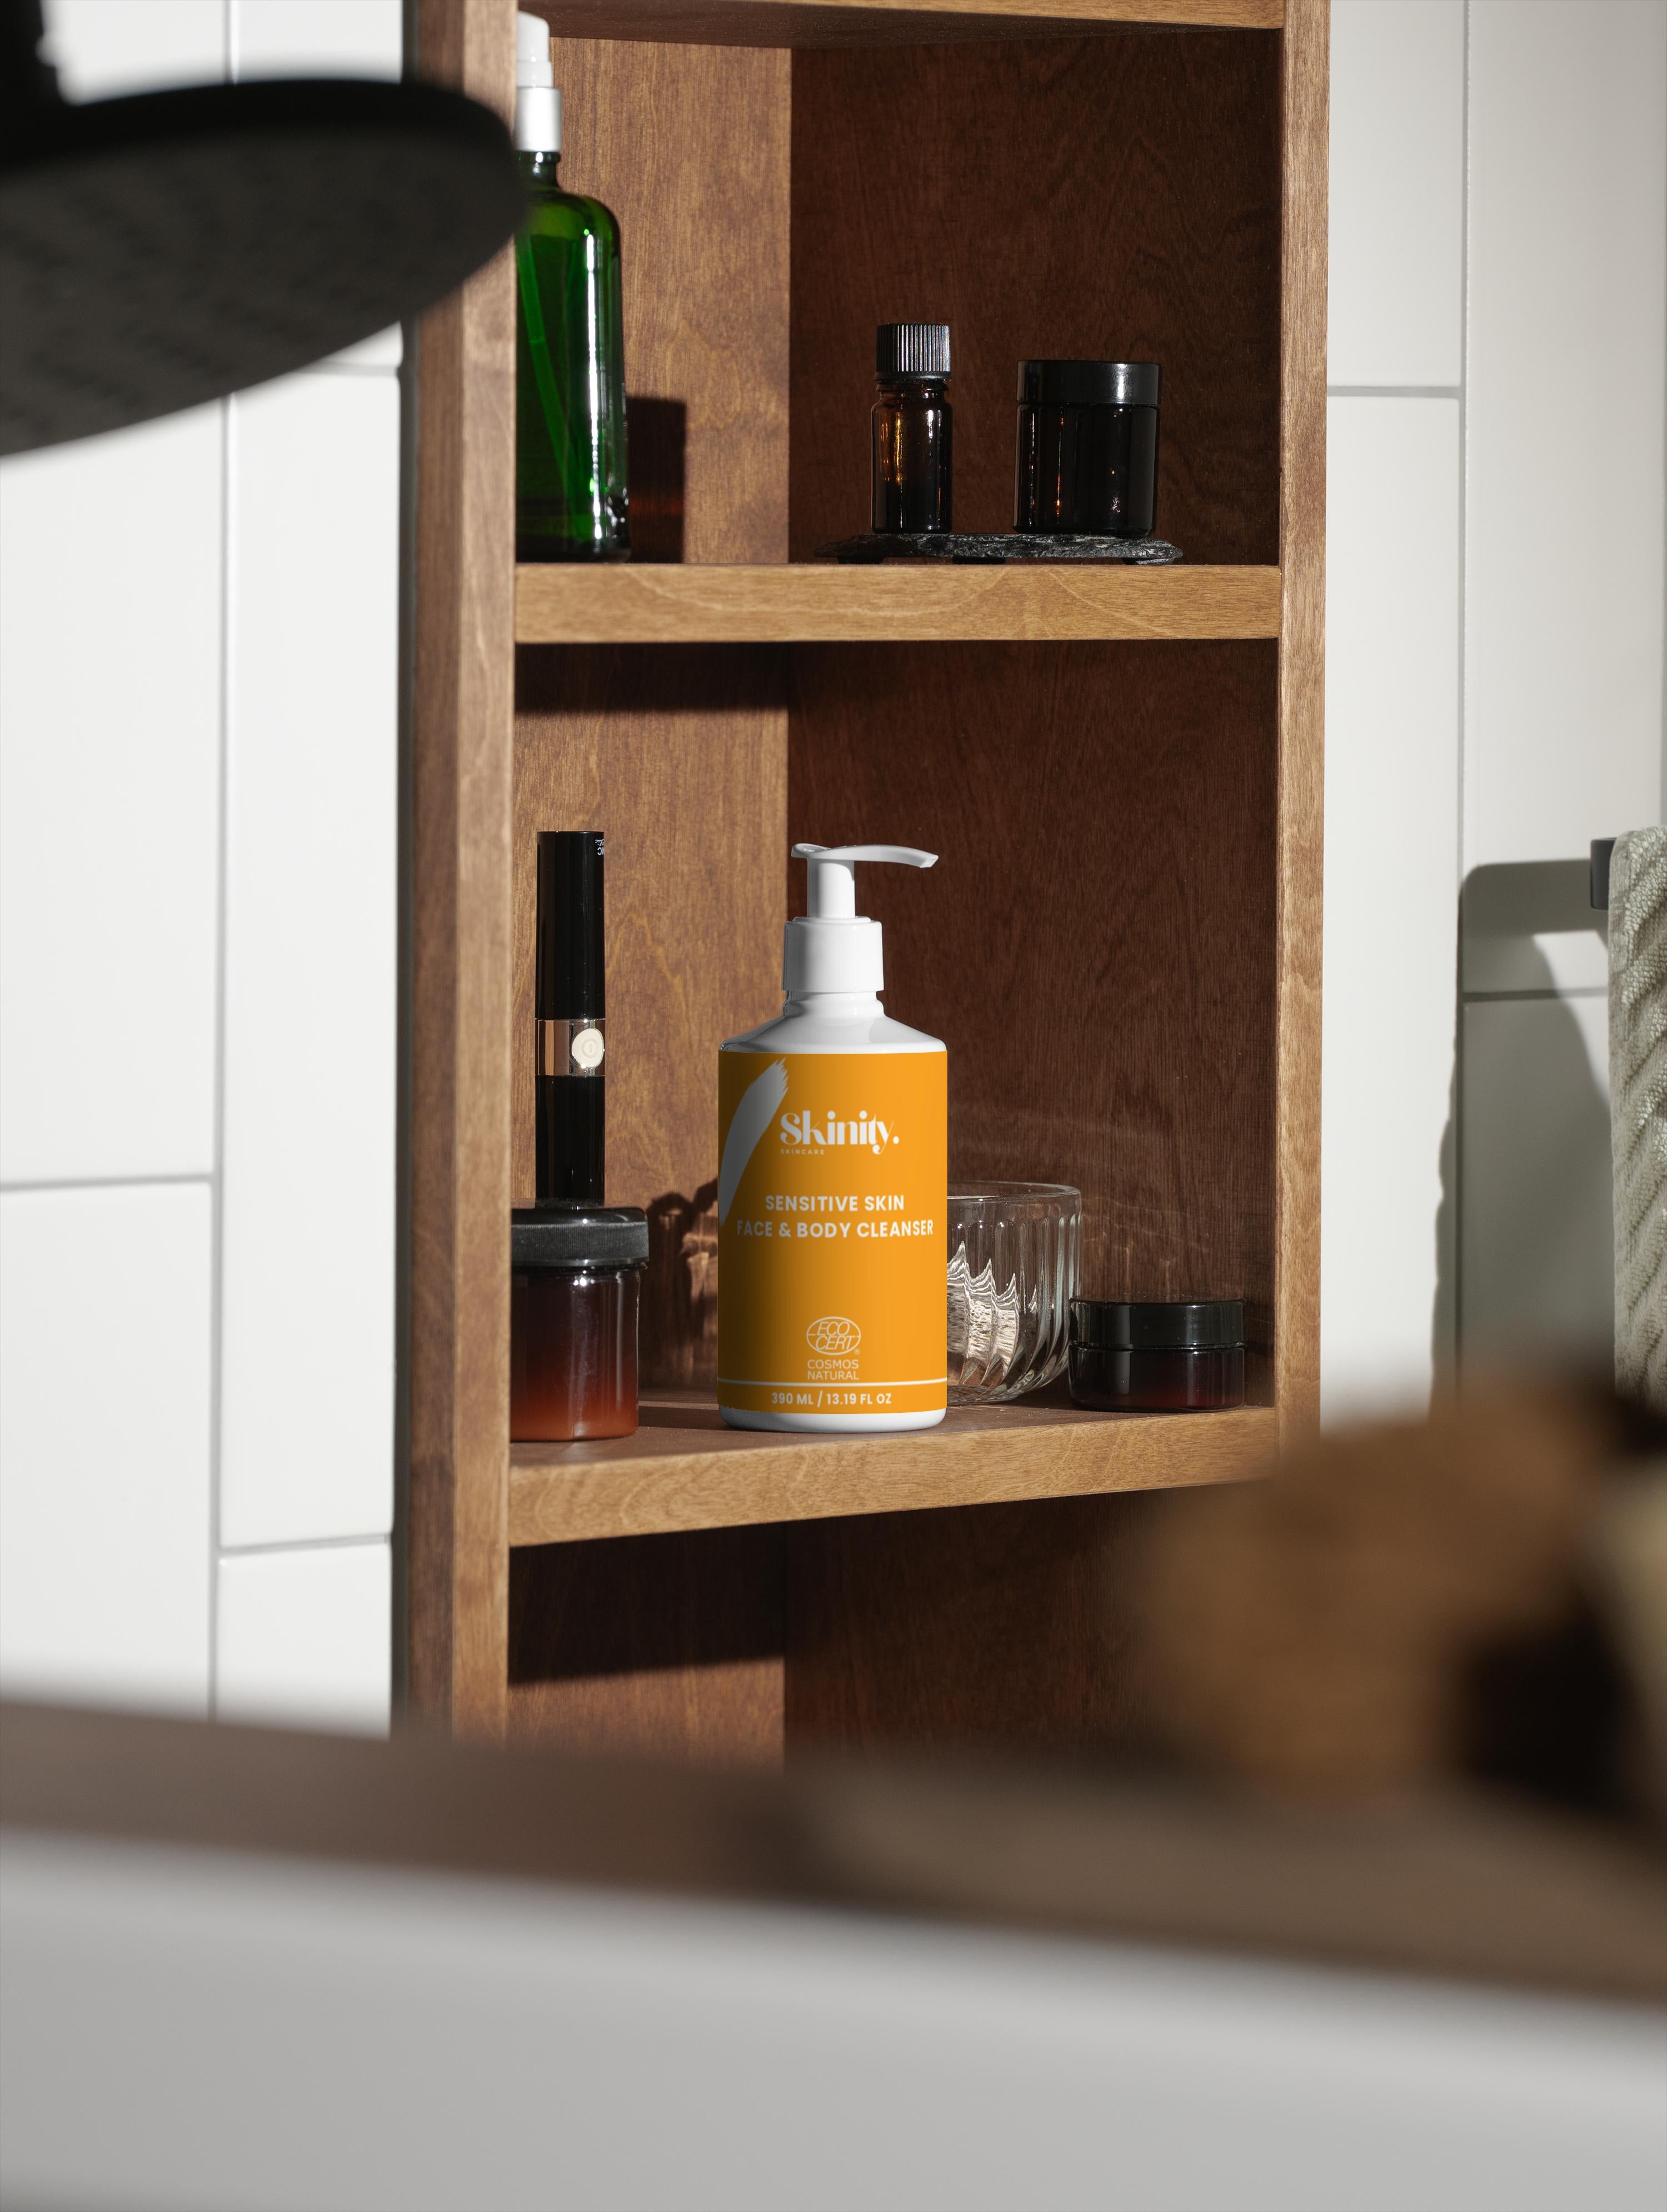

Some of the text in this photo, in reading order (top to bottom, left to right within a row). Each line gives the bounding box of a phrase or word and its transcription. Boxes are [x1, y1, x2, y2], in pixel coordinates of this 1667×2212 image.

[780, 1110, 900, 1155] Skinity.
[765, 1194, 905, 1212] SENSITIVE SKIN
[737, 1219, 934, 1238] FACE & BODY CLEANSER
[817, 1321, 851, 1336] ECO
[815, 1336, 856, 1351] CERT
[807, 1359, 860, 1370] COSMOS
[807, 1371, 860, 1381] NATURAL
[771, 1391, 892, 1408] 390 ML / 13.19 FL OZ
